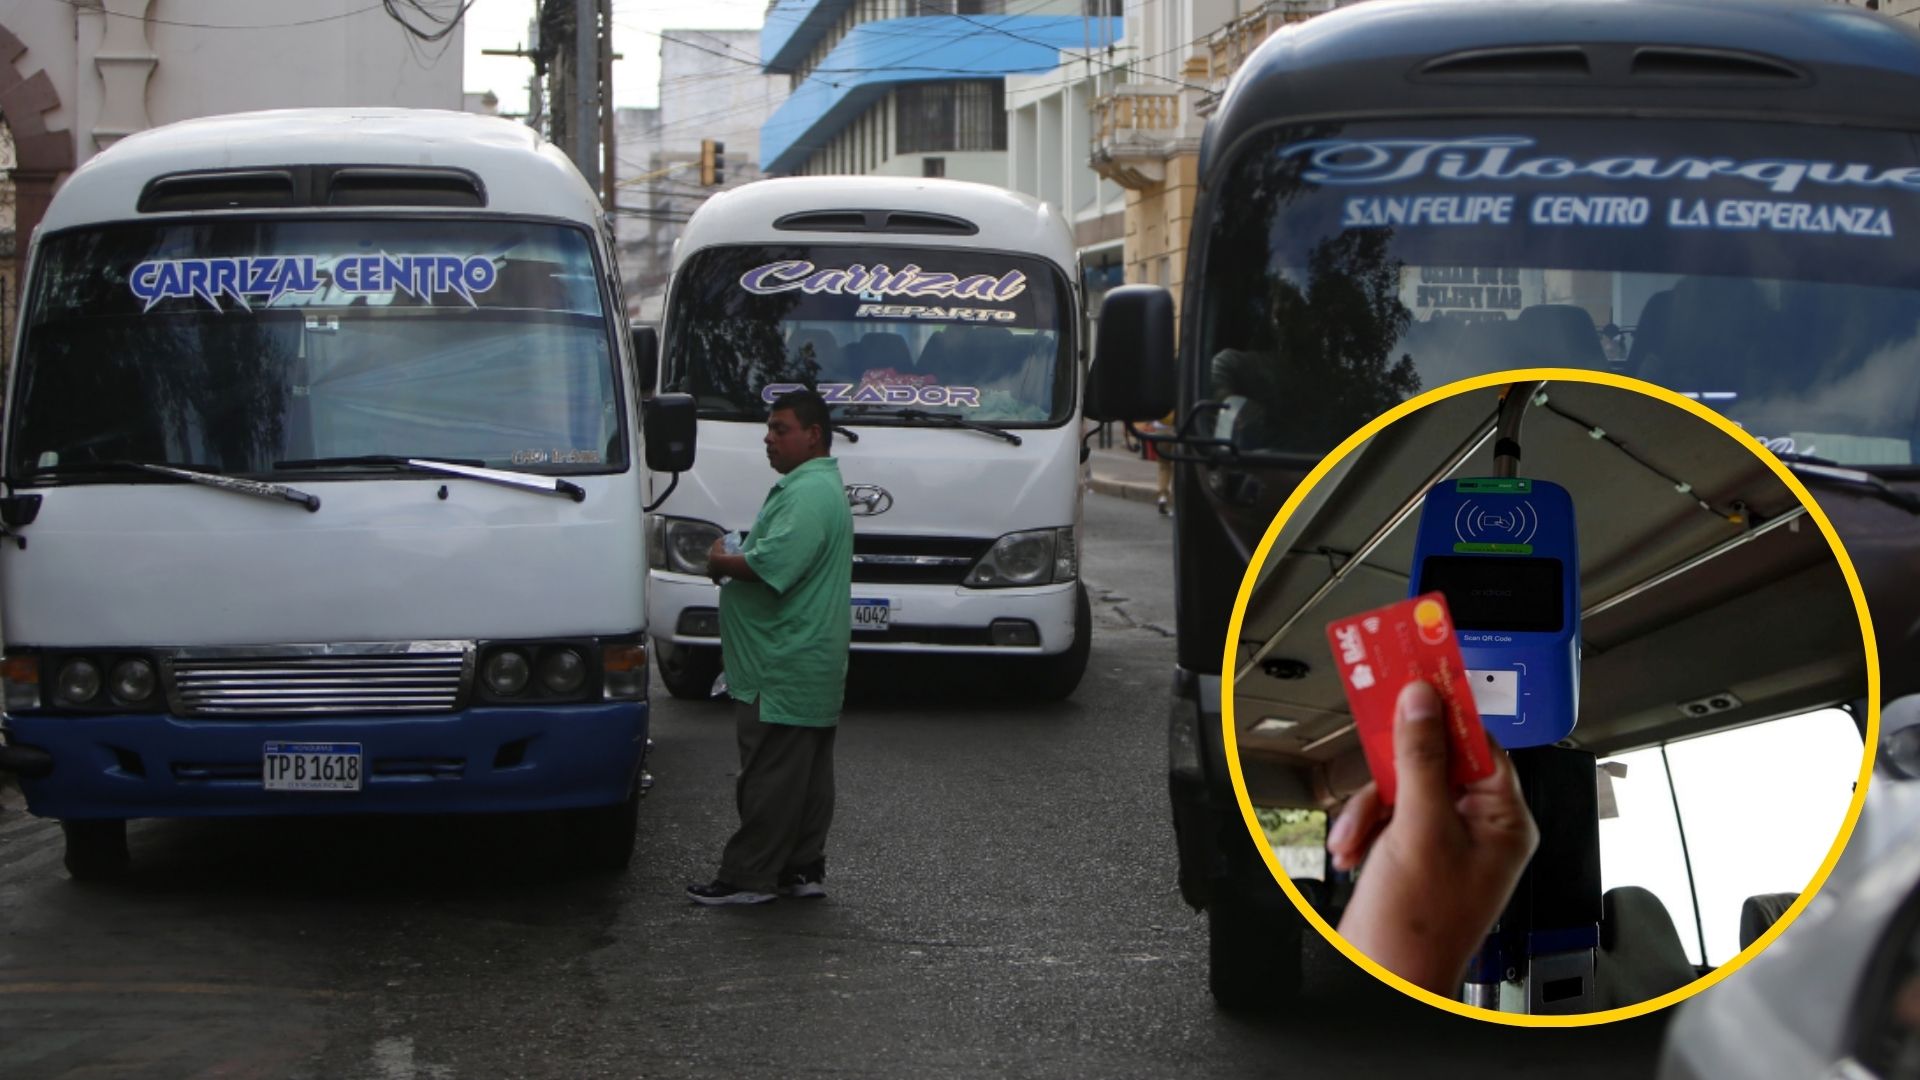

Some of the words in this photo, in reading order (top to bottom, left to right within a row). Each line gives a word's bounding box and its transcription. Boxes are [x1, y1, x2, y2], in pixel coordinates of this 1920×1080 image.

[1343, 198, 1414, 226] SAN
[1408, 197, 1514, 225] FELIPE
[1532, 197, 1650, 226] CENTRO
[1668, 199, 1710, 227] LA
[1714, 200, 1895, 236] ESPERANZA
[130, 255, 327, 314] CARRIZAL
[331, 249, 497, 310] CENTRO
[739, 259, 1027, 302] Carrizal
[856, 303, 1017, 322] REPARTO
[855, 606, 888, 624] 4042
